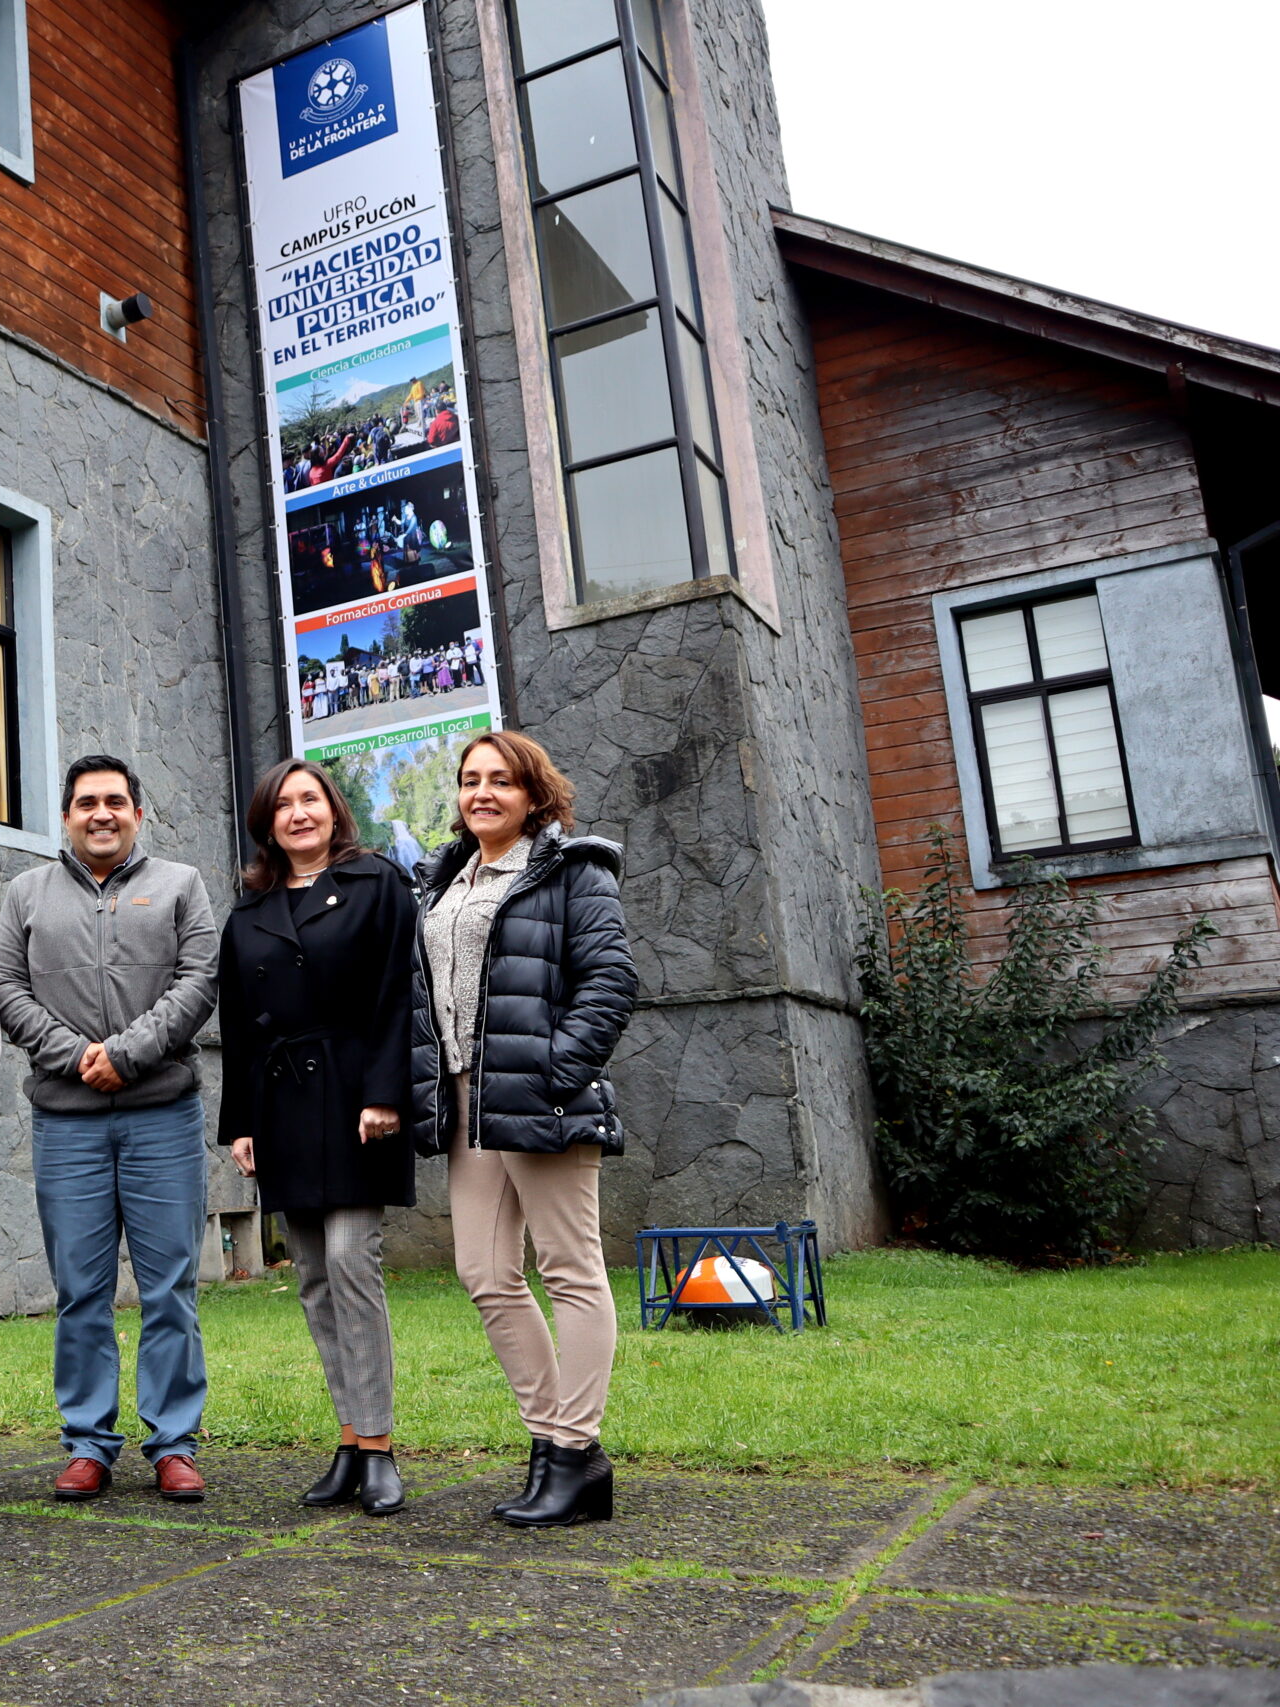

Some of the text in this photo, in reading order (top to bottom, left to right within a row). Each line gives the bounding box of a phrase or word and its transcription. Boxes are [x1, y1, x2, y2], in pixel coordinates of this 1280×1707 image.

[289, 104, 385, 149] UNIVERSIDAD
[290, 113, 386, 160] DE LA FRONTERA
[280, 194, 416, 258] CAMPUS PUCÓN
[323, 195, 367, 223] UFRO
[270, 242, 438, 320] UNIVERSIDAD
[274, 345, 296, 365] EN
[301, 338, 320, 356] EL
[310, 340, 412, 381] Ciencia Ciudadana
[332, 466, 411, 497] Arte & Cultura
[326, 588, 442, 625] Formación Continua
[320, 716, 473, 759] Turismo y Desarrollo Local
